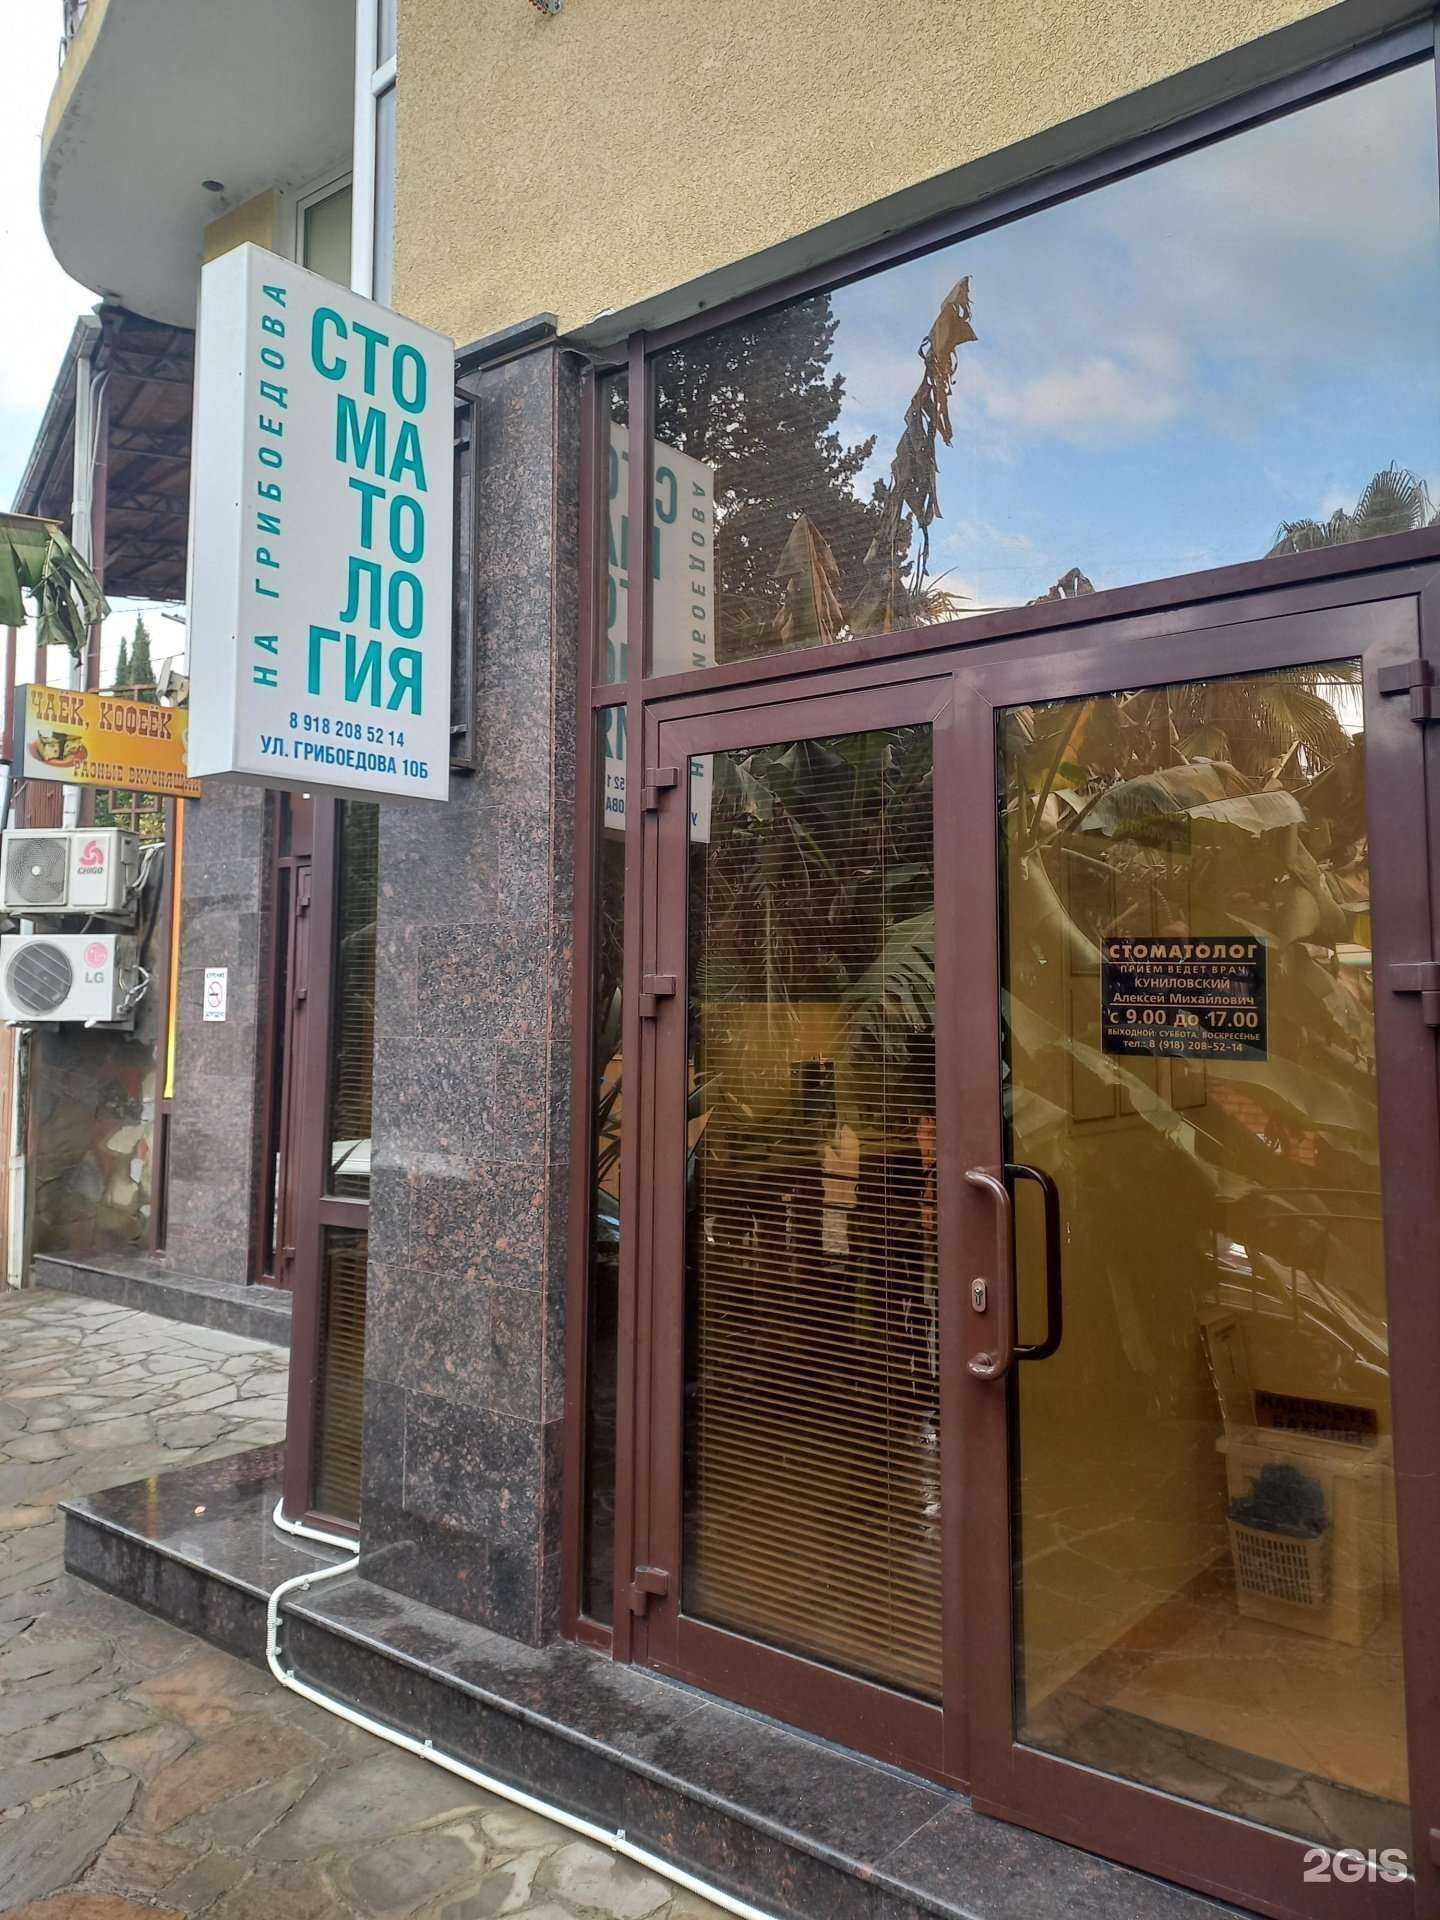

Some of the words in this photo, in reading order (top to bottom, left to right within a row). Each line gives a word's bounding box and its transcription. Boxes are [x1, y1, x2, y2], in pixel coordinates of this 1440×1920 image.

[311, 306, 428, 415] СТО
[255, 284, 288, 599] ГРИБОЕДОВА
[336, 393, 428, 492] МА
[348, 476, 425, 564] ТО
[339, 556, 424, 640] ЛО
[254, 634, 279, 688] НА
[308, 624, 423, 717] ГИЯ
[100, 701, 173, 740] КОФЕЁК
[289, 712, 298, 728] 8
[303, 714, 330, 735] 918
[335, 720, 362, 740] 208
[367, 726, 383, 744] 52
[388, 730, 405, 747] 14
[260, 735, 289, 757] УЛ.
[294, 741, 397, 774] ГРИБОЕДОВА
[402, 758, 428, 779] 10Б
[1109, 943, 1257, 959] СТОМАТОЛОГ
[1167, 965, 1206, 974] ВЕДЕТ
[1211, 965, 1246, 975] ВРАЧ
[85, 972, 104, 983] LG
[1134, 977, 1231, 989] КУНИЛОВСКИЙ
[1113, 991, 1165, 1004] Алексей
[1169, 993, 1255, 1006] Михайлович
[1126, 1009, 1167, 1025] 9.00
[1173, 1014, 1199, 1028] до
[1207, 1011, 1258, 1028] 17.00
[1149, 1040, 1155, 1048] 8
[1159, 1040, 1185, 1051] (918)
[1187, 1041, 1243, 1052] 208-52-14
